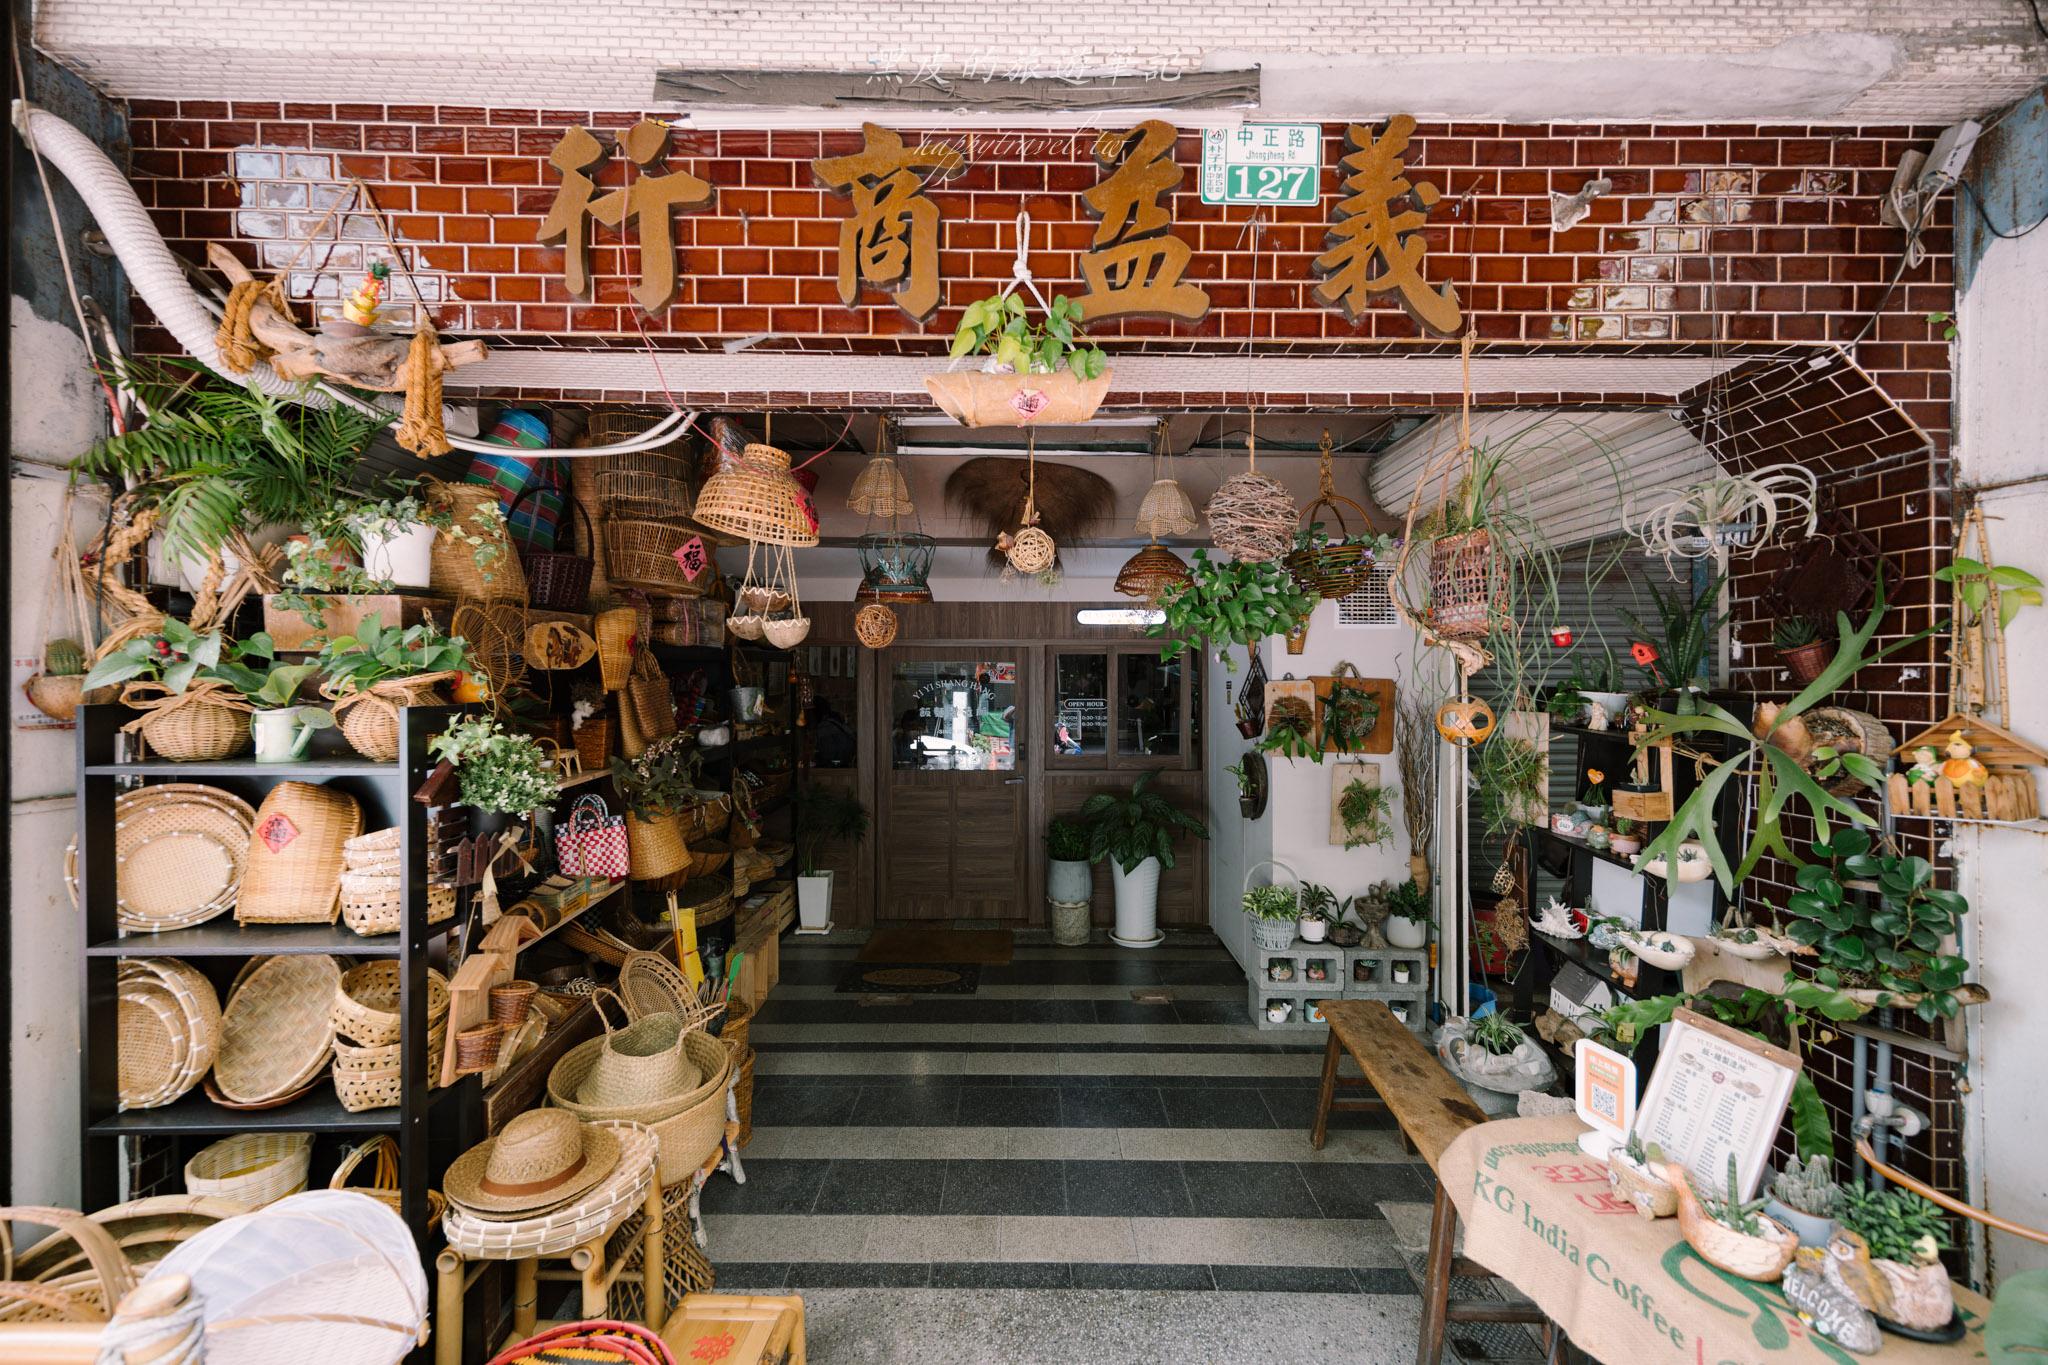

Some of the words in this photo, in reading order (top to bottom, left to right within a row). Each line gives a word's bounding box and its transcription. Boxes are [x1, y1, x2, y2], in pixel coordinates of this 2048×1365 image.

[1237, 127, 1305, 147] 中正路
[1207, 145, 1224, 172] 朴子市
[1235, 166, 1309, 200] 127
[935, 679, 968, 690] SHANG
[970, 682, 997, 701] HANG
[1473, 1170, 1515, 1214] KG
[1521, 1200, 1579, 1266] India
[1586, 1253, 1685, 1350] Coffee
